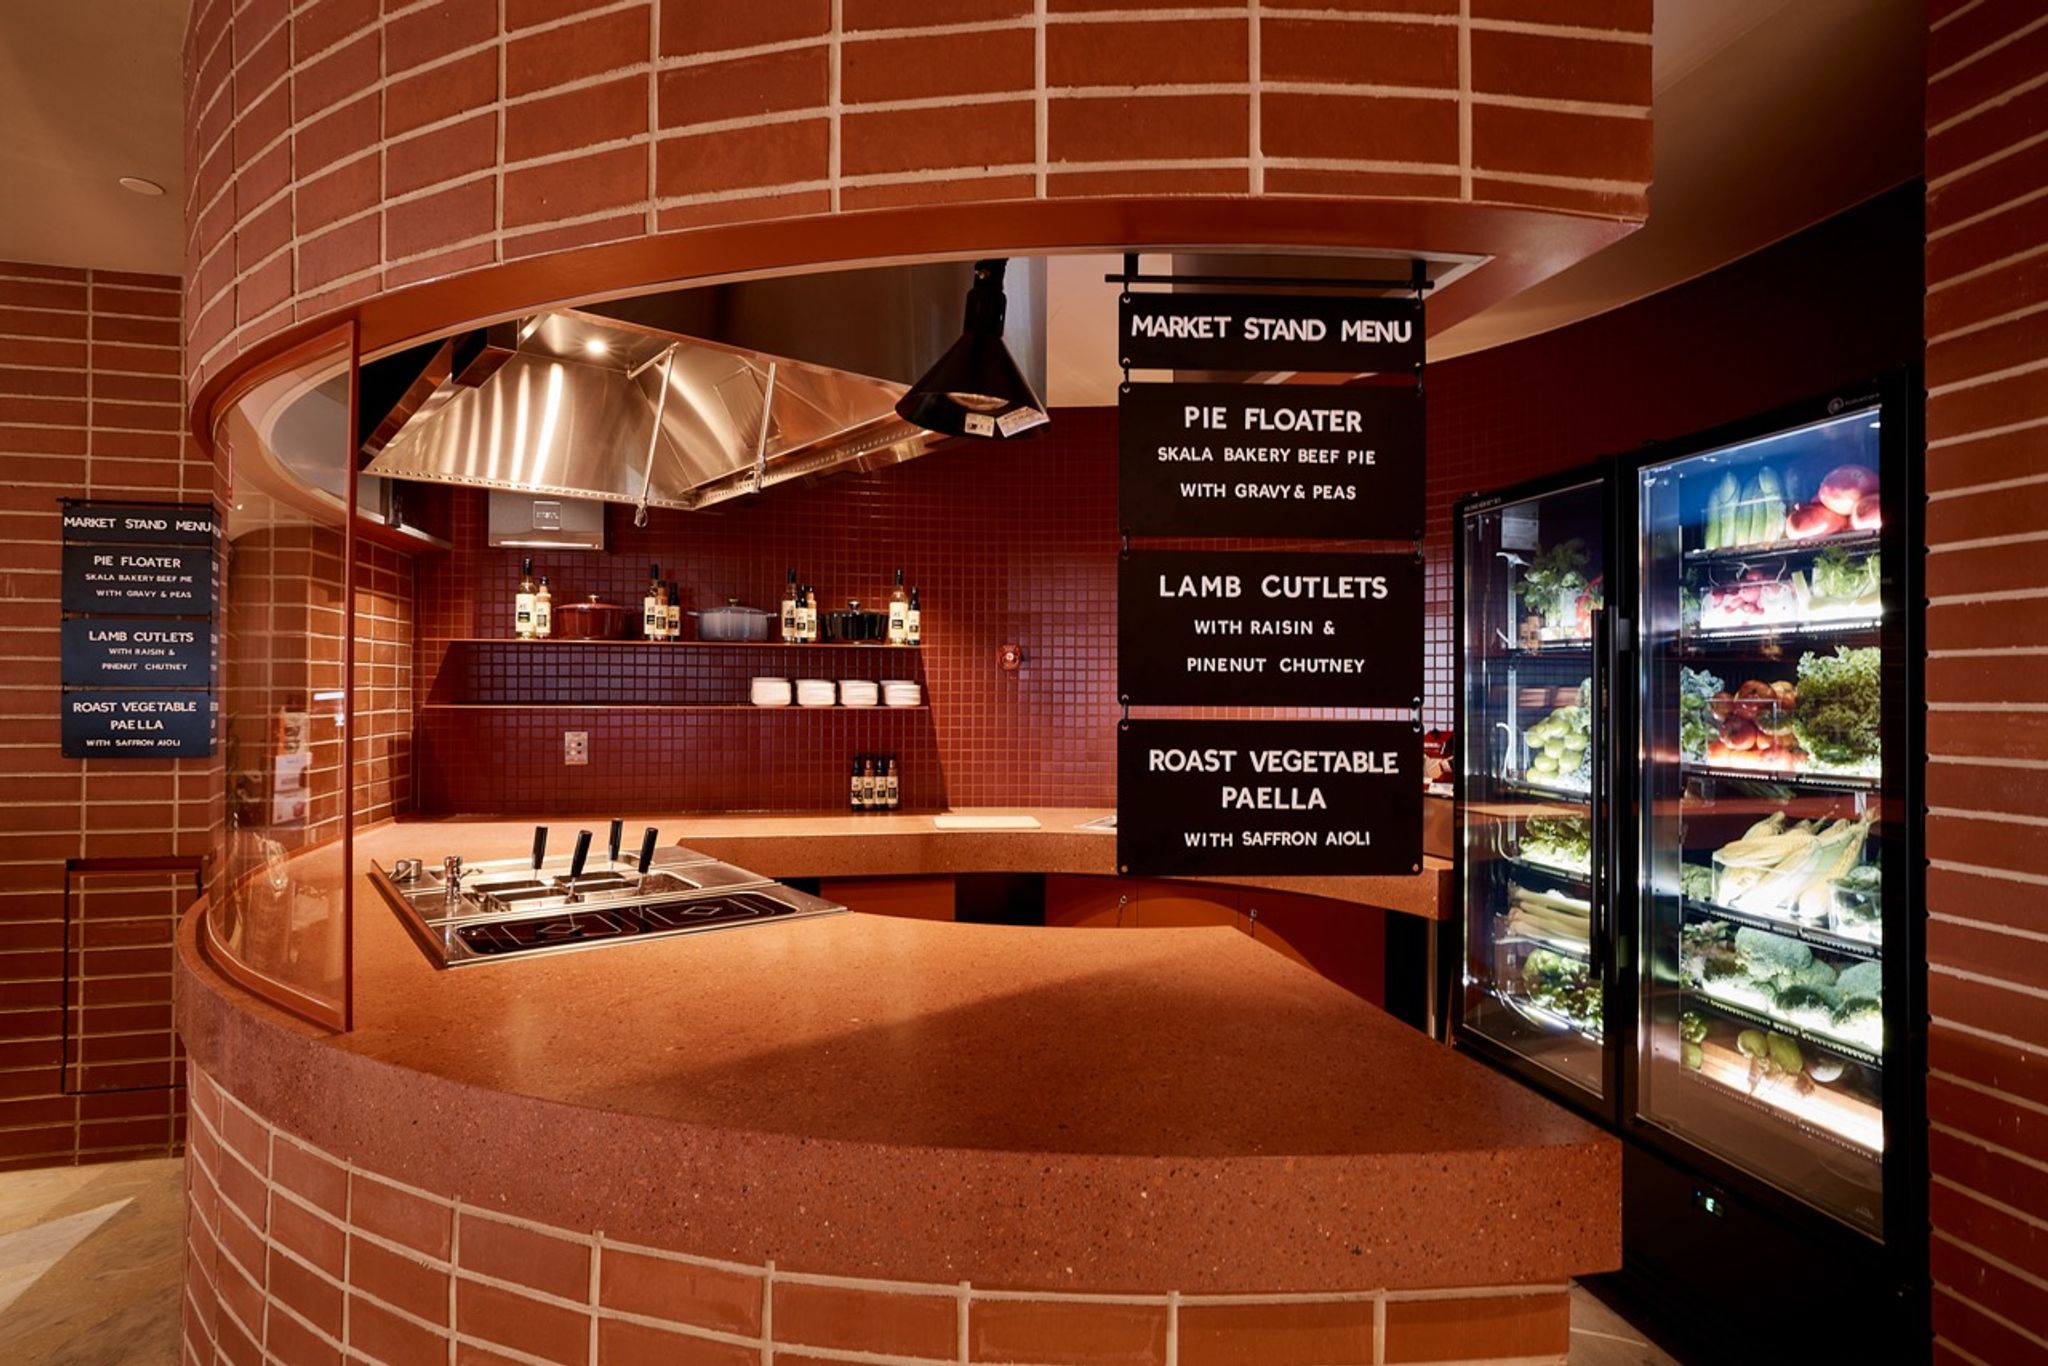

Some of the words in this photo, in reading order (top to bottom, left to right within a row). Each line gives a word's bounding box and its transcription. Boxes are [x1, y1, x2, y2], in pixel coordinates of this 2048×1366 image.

[1132, 315, 1231, 338] MARKET
[1244, 317, 1326, 341] STAND
[1341, 320, 1411, 343] MENU
[1185, 406, 1226, 429] PIE
[1245, 408, 1362, 432] FLOATER
[1158, 447, 1213, 461] SKALA
[1224, 448, 1290, 462] BAKERY
[1298, 449, 1339, 463] BEEF
[1348, 450, 1375, 464] PIE
[1181, 483, 1225, 497] WITH
[1235, 484, 1290, 498] GRAVY
[1294, 485, 1305, 498] &
[1313, 485, 1356, 500] PEAS
[64, 517, 116, 528] MARKET
[125, 519, 167, 530] STAND
[176, 521, 211, 532] MENU
[94, 555, 113, 566] PIE
[121, 556, 180, 568] FLOATER
[127, 590, 156, 598] GRAVY
[170, 591, 191, 599] PEAS
[1160, 575, 1241, 597] LAMB
[1261, 575, 1388, 599] CUTLETS
[1195, 620, 1242, 634] WITH
[1251, 620, 1312, 634] RAISIN
[1323, 621, 1335, 635] &
[89, 631, 127, 641] LAMB
[133, 632, 194, 642] CUTLETS
[145, 663, 187, 671] CHUTNEY
[1188, 658, 1266, 672] PINENUT
[1280, 658, 1364, 673] CHUTNEY
[73, 702, 117, 712] ROAST
[122, 702, 196, 712] VEGETABLE
[111, 720, 163, 730] PAELLA
[1150, 749, 1237, 772] ROAST
[1250, 750, 1399, 774] VEGETABLE
[1222, 786, 1326, 809] PAELLA
[1184, 833, 1233, 847] WITH
[1242, 831, 1317, 845] SAFFRON
[1326, 831, 1370, 845] AIOLI
